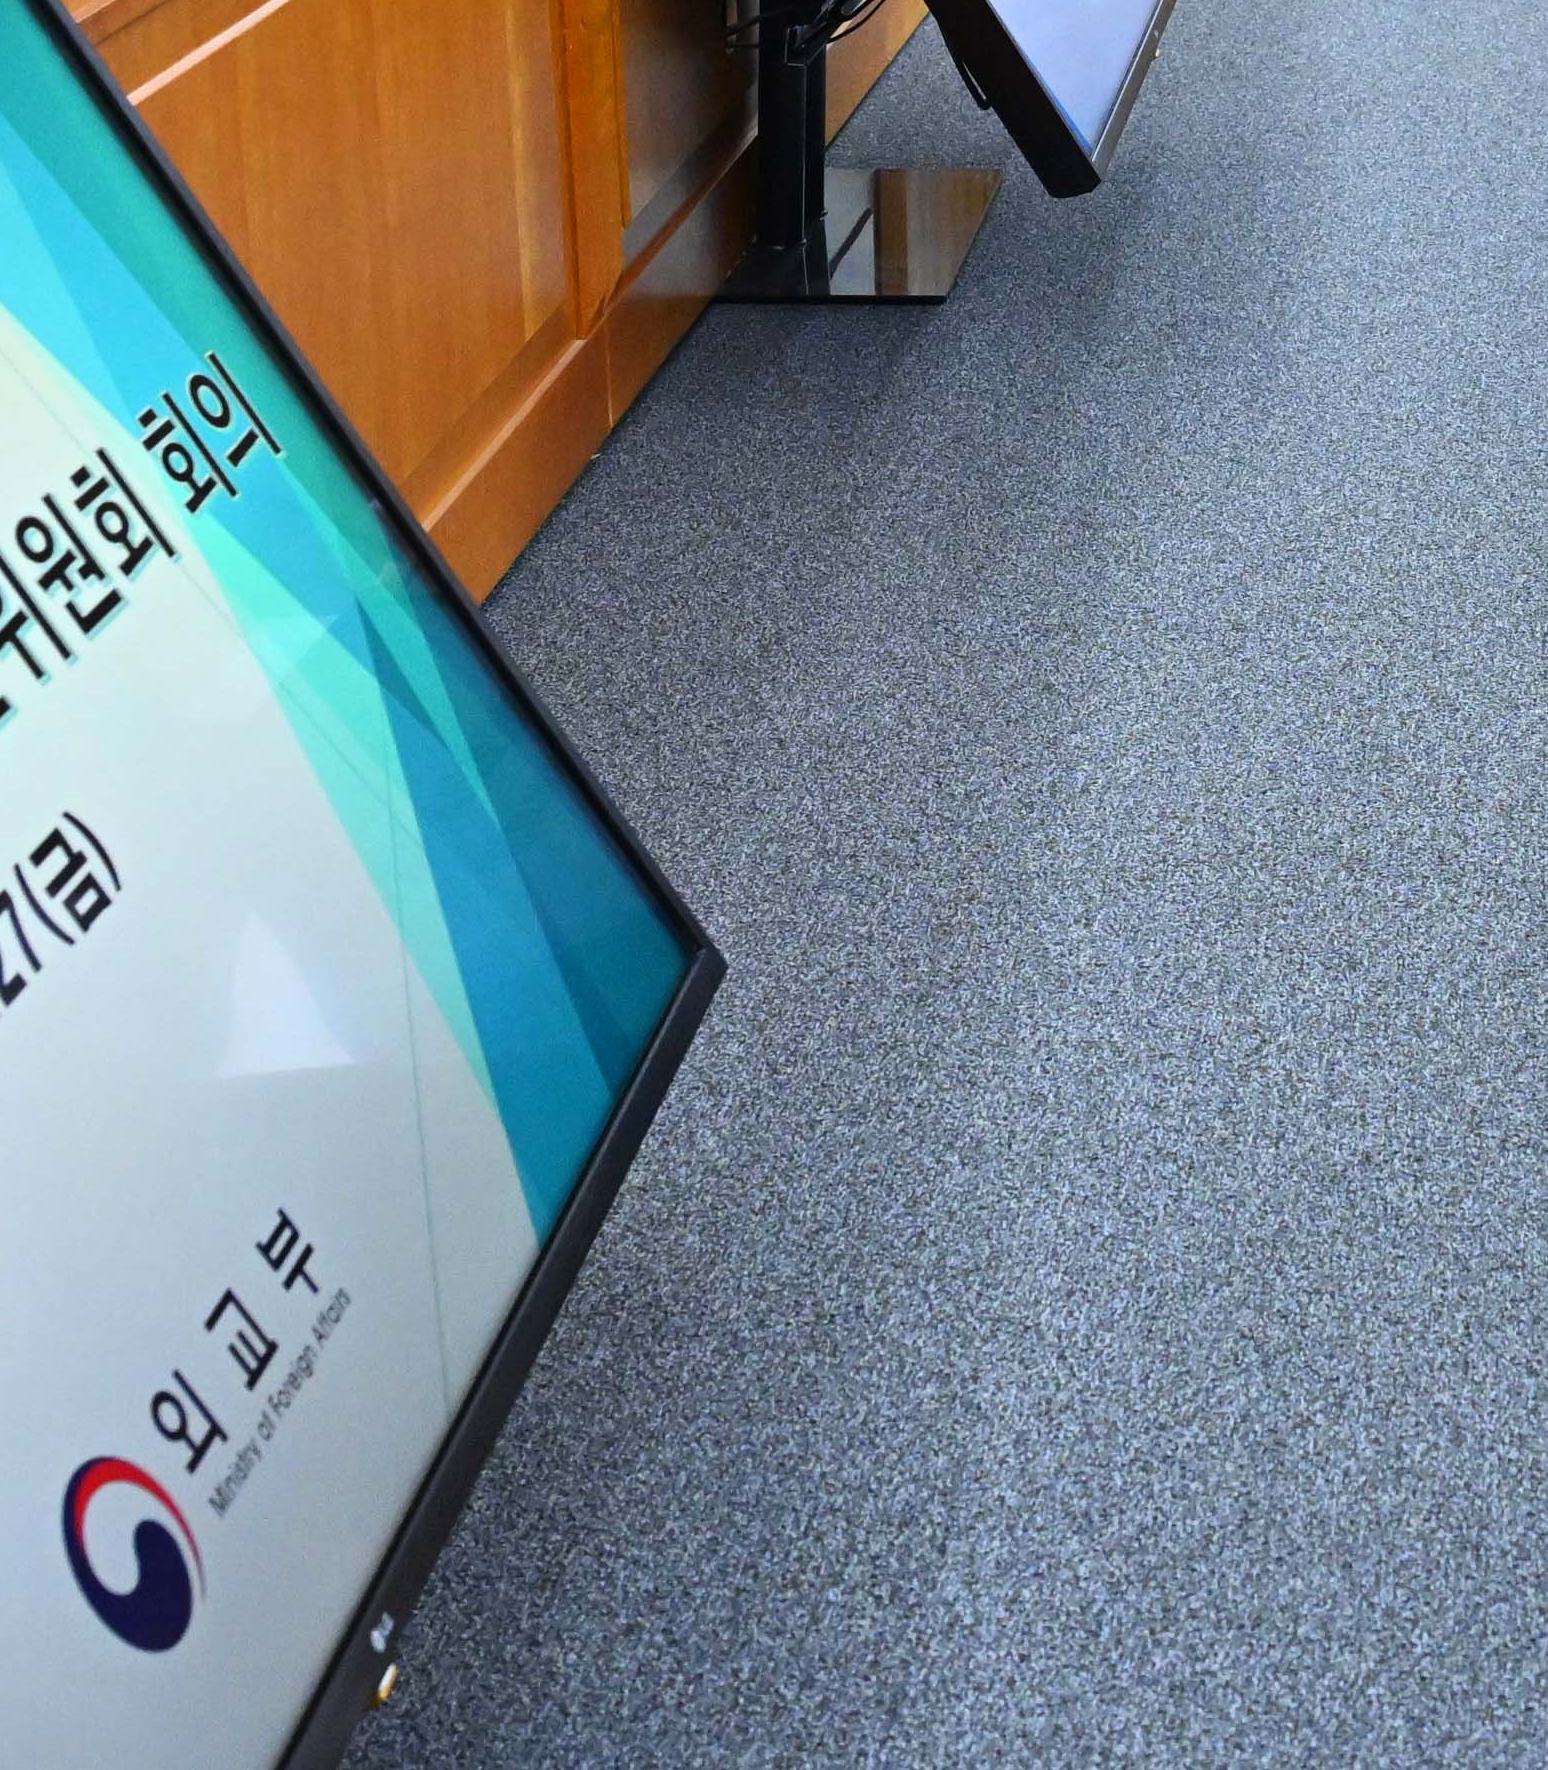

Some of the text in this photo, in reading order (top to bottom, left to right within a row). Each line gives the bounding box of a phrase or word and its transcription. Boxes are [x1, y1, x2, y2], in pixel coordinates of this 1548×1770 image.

[139, 353, 281, 511] 회의
[151, 1209, 319, 1474] 외교부
[267, 1342, 320, 1414] Foreign
[258, 1409, 278, 1442] of
[207, 1435, 263, 1518] Ministry
